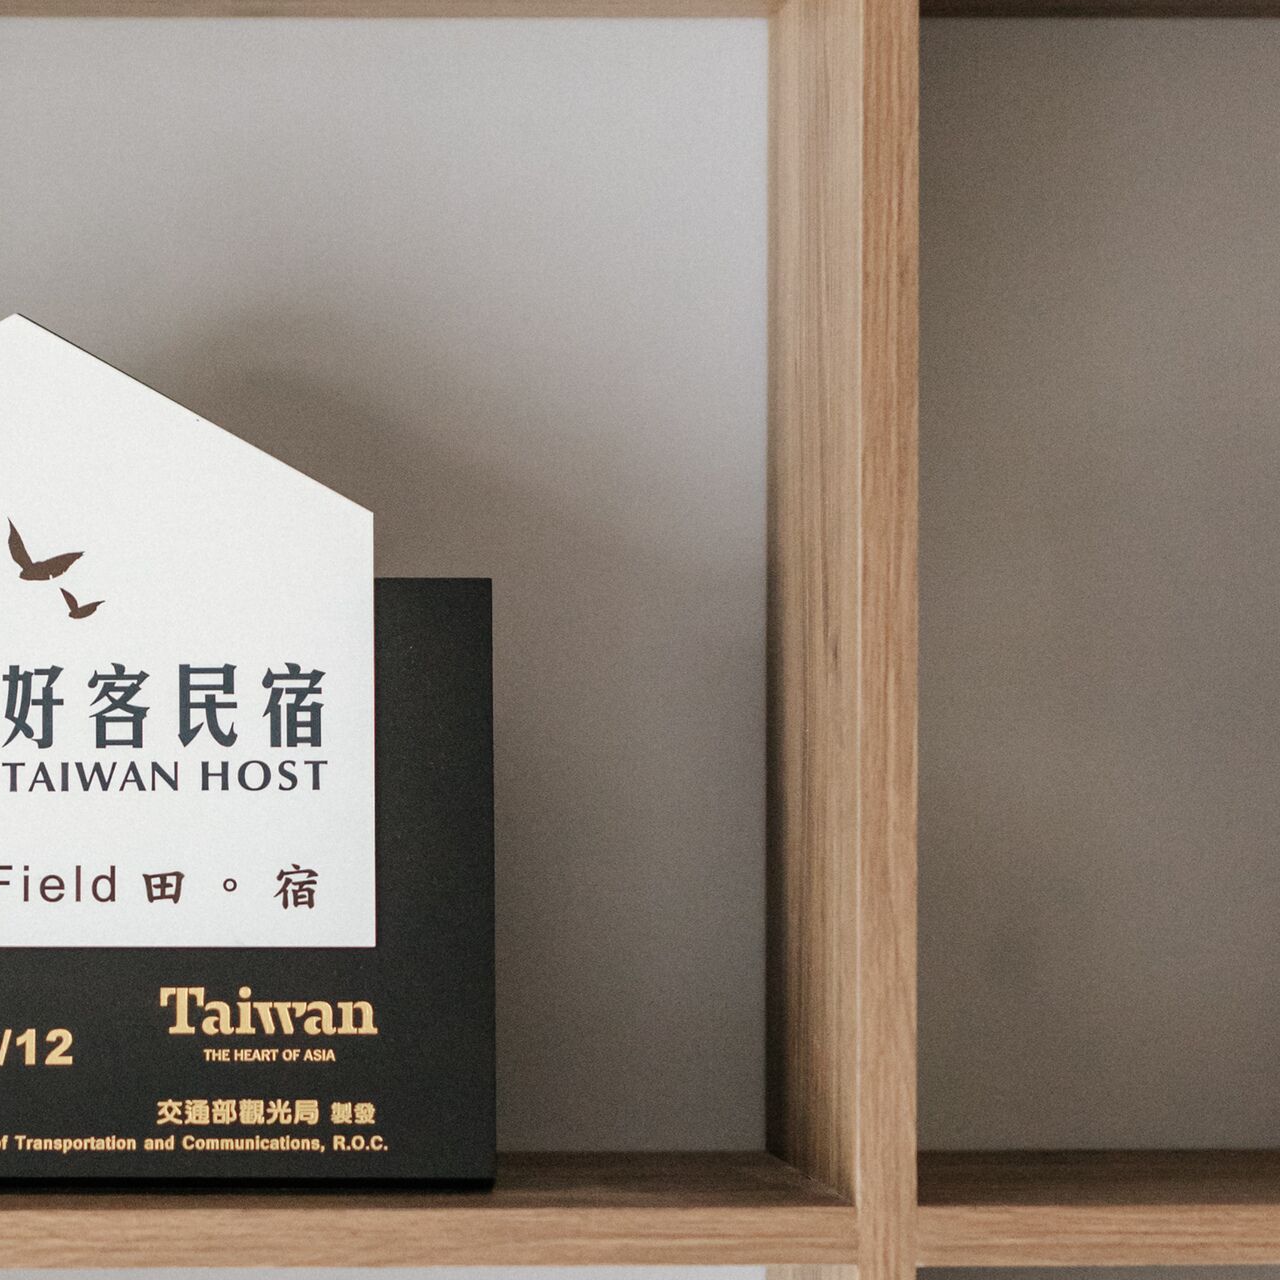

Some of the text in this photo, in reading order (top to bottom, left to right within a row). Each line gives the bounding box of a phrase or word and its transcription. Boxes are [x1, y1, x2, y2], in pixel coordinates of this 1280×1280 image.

[2, 662, 326, 749] 好客民宿
[2, 760, 328, 792] TAIWAN HOST
[159, 986, 379, 1036] Taiwan
[203, 1048, 336, 1062] THE HEART OF ASIA
[157, 1098, 376, 1126] 交通部觀光局 製發
[14, 1135, 136, 1155] Transportation
[144, 1135, 174, 1150] and
[182, 1135, 325, 1153] Communications,
[333, 1135, 388, 1151] R.O.C.
